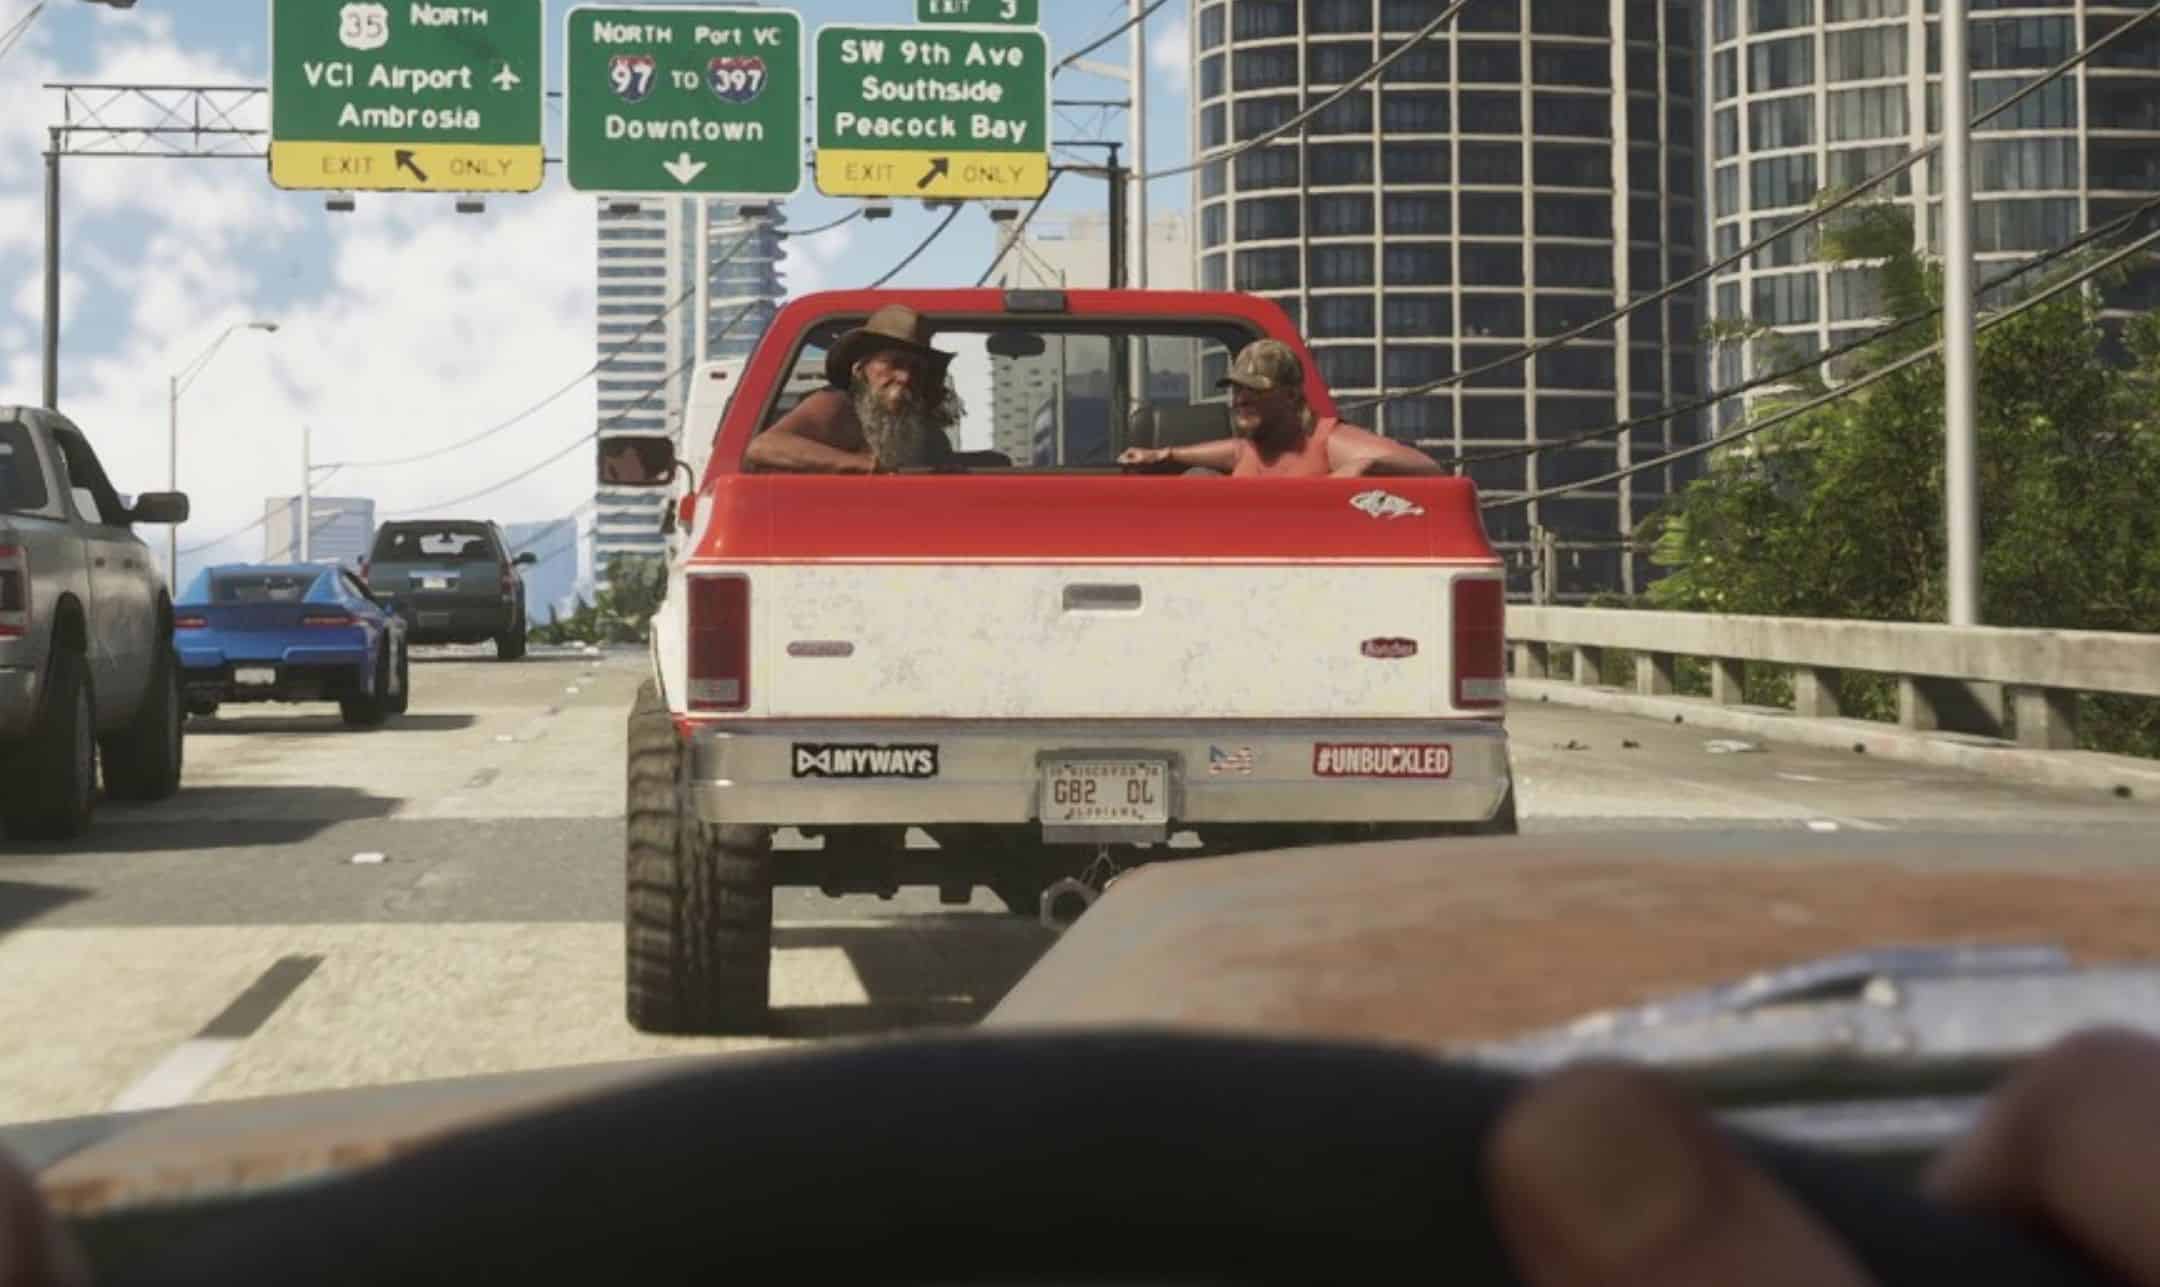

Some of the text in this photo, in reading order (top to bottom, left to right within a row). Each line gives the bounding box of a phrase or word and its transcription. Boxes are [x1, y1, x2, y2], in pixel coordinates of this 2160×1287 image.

[410, 3, 488, 26] NORTH
[929, 0, 1016, 18] EXIT 3
[346, 12, 383, 38] 35
[593, 20, 782, 46] NORTH Port VC
[840, 39, 1024, 67] SW 9th Ave
[303, 62, 472, 94] VCI Airport
[610, 63, 654, 93] 97
[671, 70, 698, 89] TO
[715, 69, 763, 92] 397
[861, 75, 1003, 103] Southside
[337, 102, 480, 129] Ambrosia
[605, 113, 764, 140] Downtown
[835, 111, 1027, 144] Peacock Bay
[322, 156, 513, 177] EXIT ONLY
[845, 162, 1024, 184] EXIT ONLY
[834, 749, 933, 774] MYWAYS
[1317, 746, 1449, 774] #UNBUCKLED
